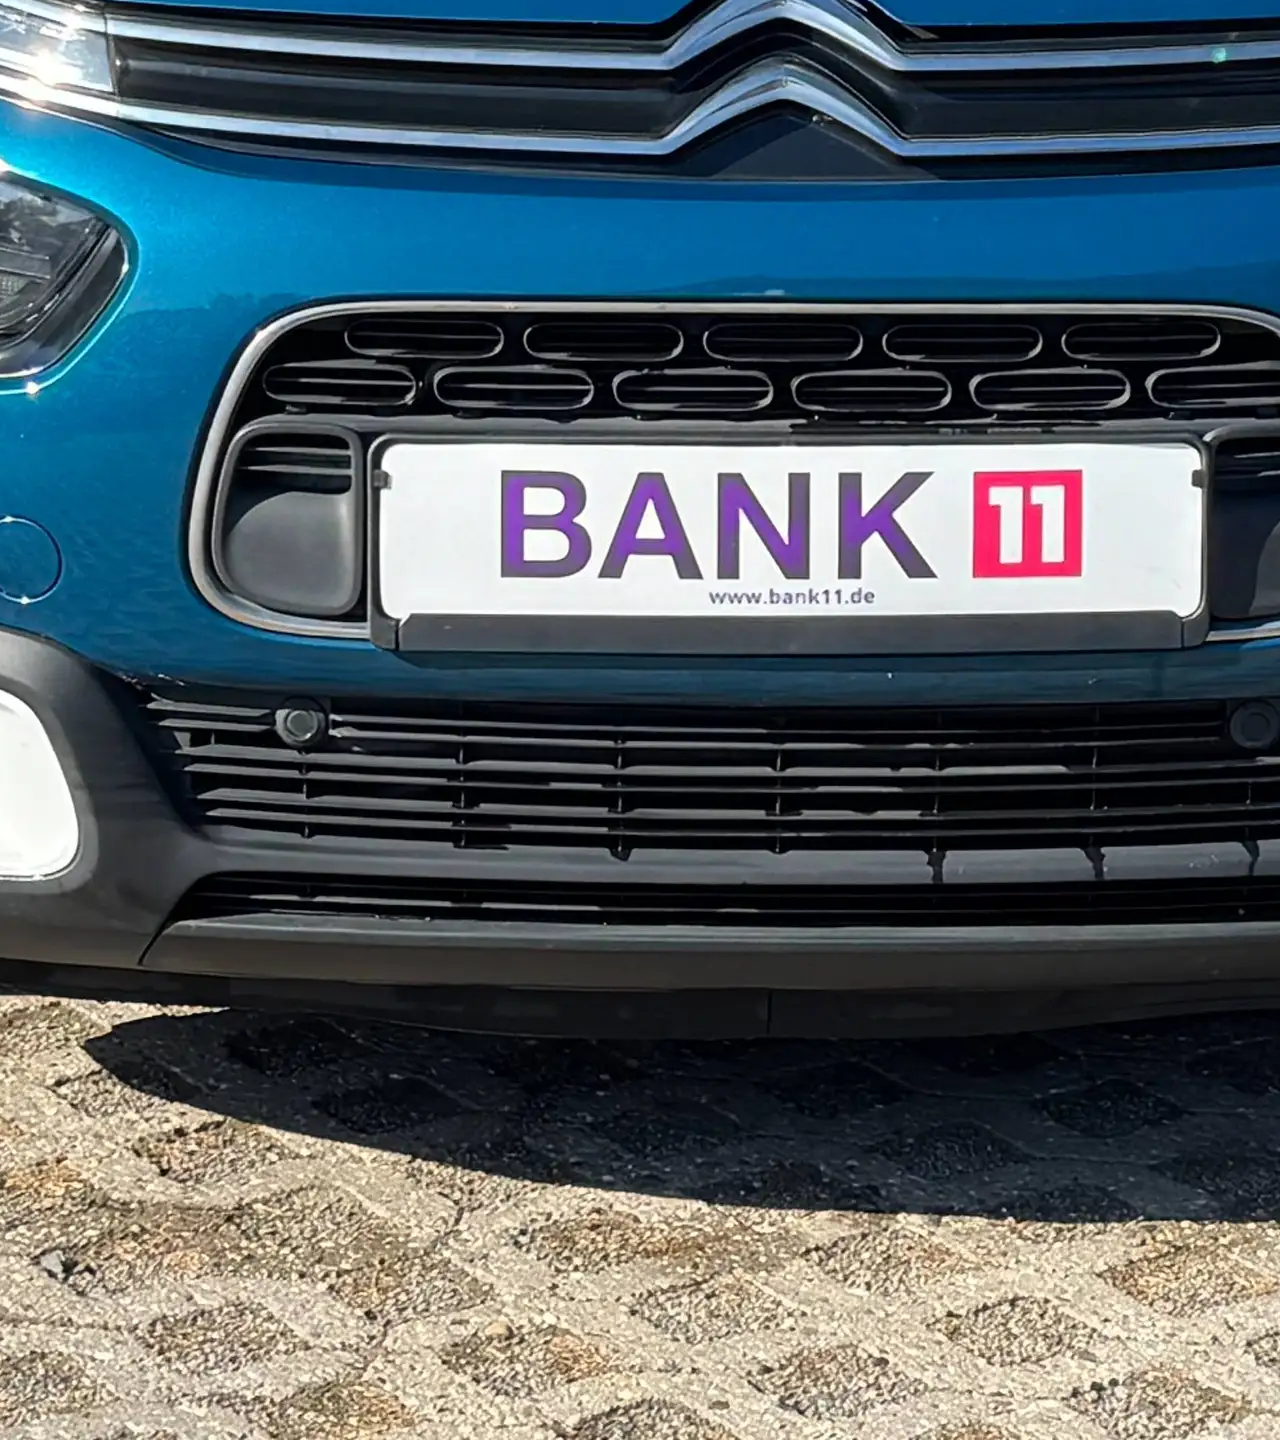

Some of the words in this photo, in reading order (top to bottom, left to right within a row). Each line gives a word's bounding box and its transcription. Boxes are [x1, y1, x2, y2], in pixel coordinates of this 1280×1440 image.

[500, 469, 938, 580] BANK
[983, 479, 1070, 569] 11
[708, 587, 876, 606] www.bank11.de
